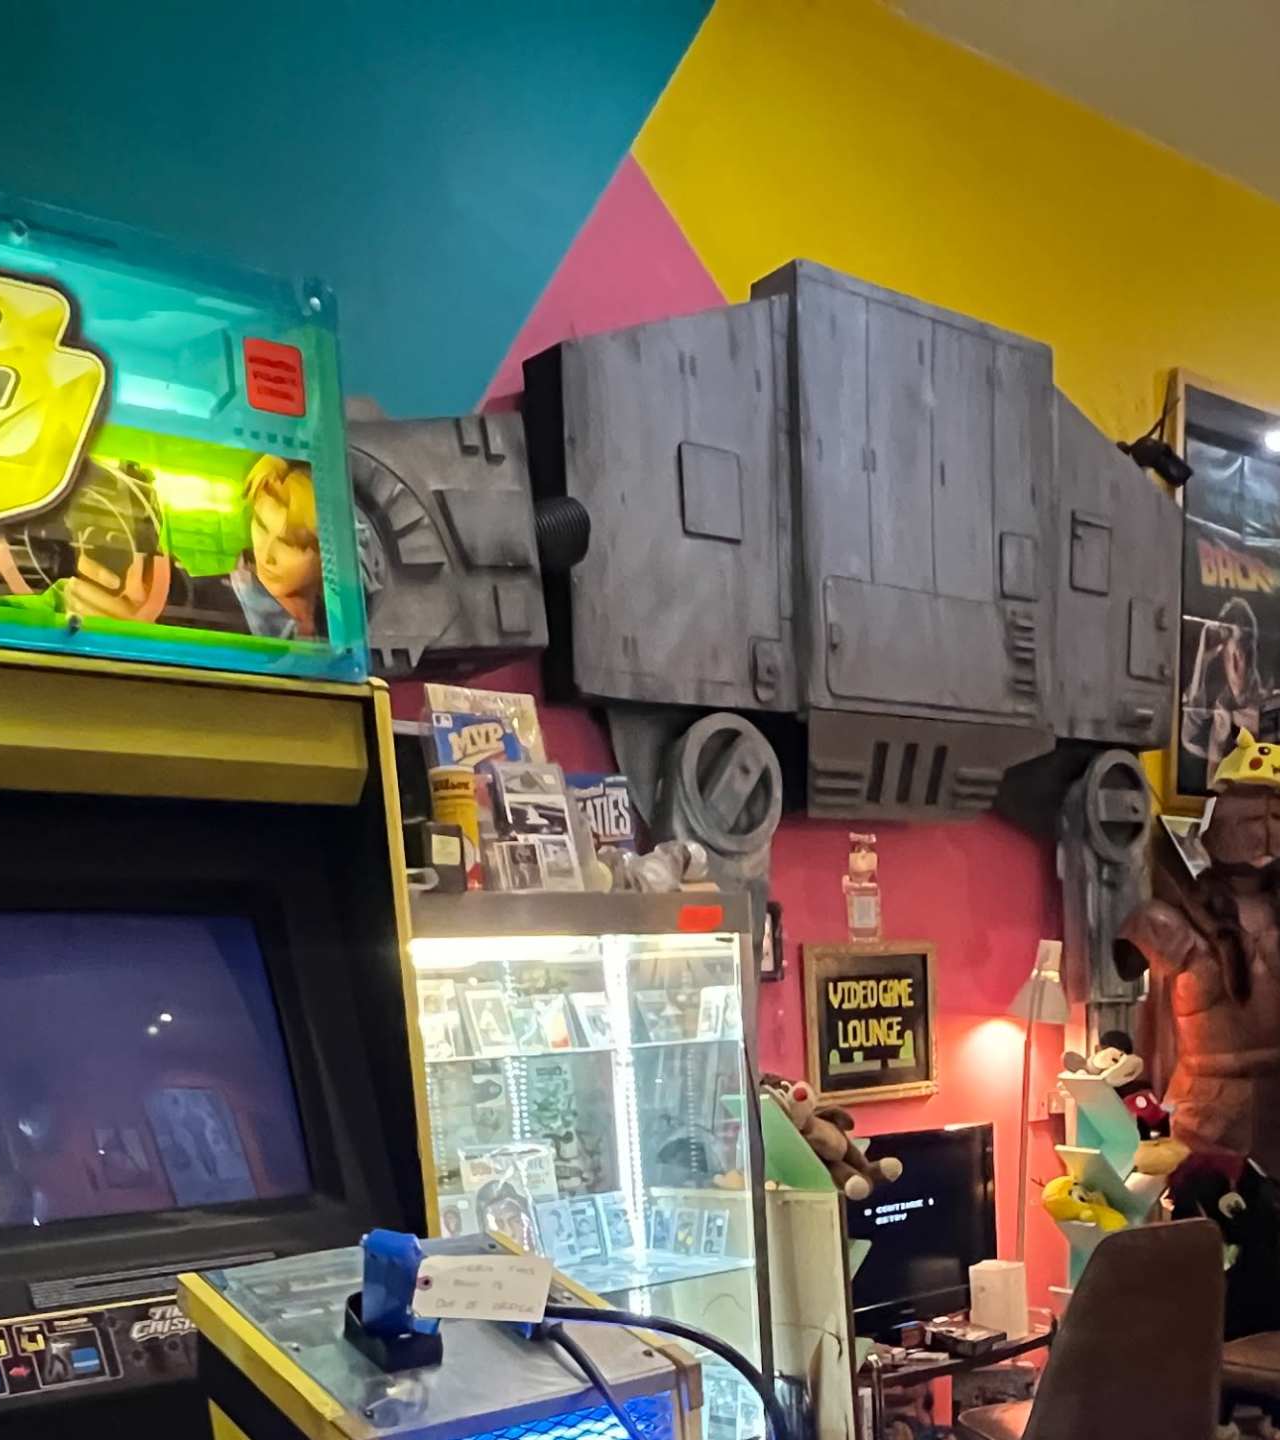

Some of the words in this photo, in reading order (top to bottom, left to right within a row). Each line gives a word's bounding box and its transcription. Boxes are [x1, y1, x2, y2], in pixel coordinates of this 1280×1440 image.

[448, 721, 506, 763] MVP
[828, 980, 878, 1009] VIDEO
[878, 978, 914, 1008] GAME
[838, 1016, 904, 1048] LOUNGE
